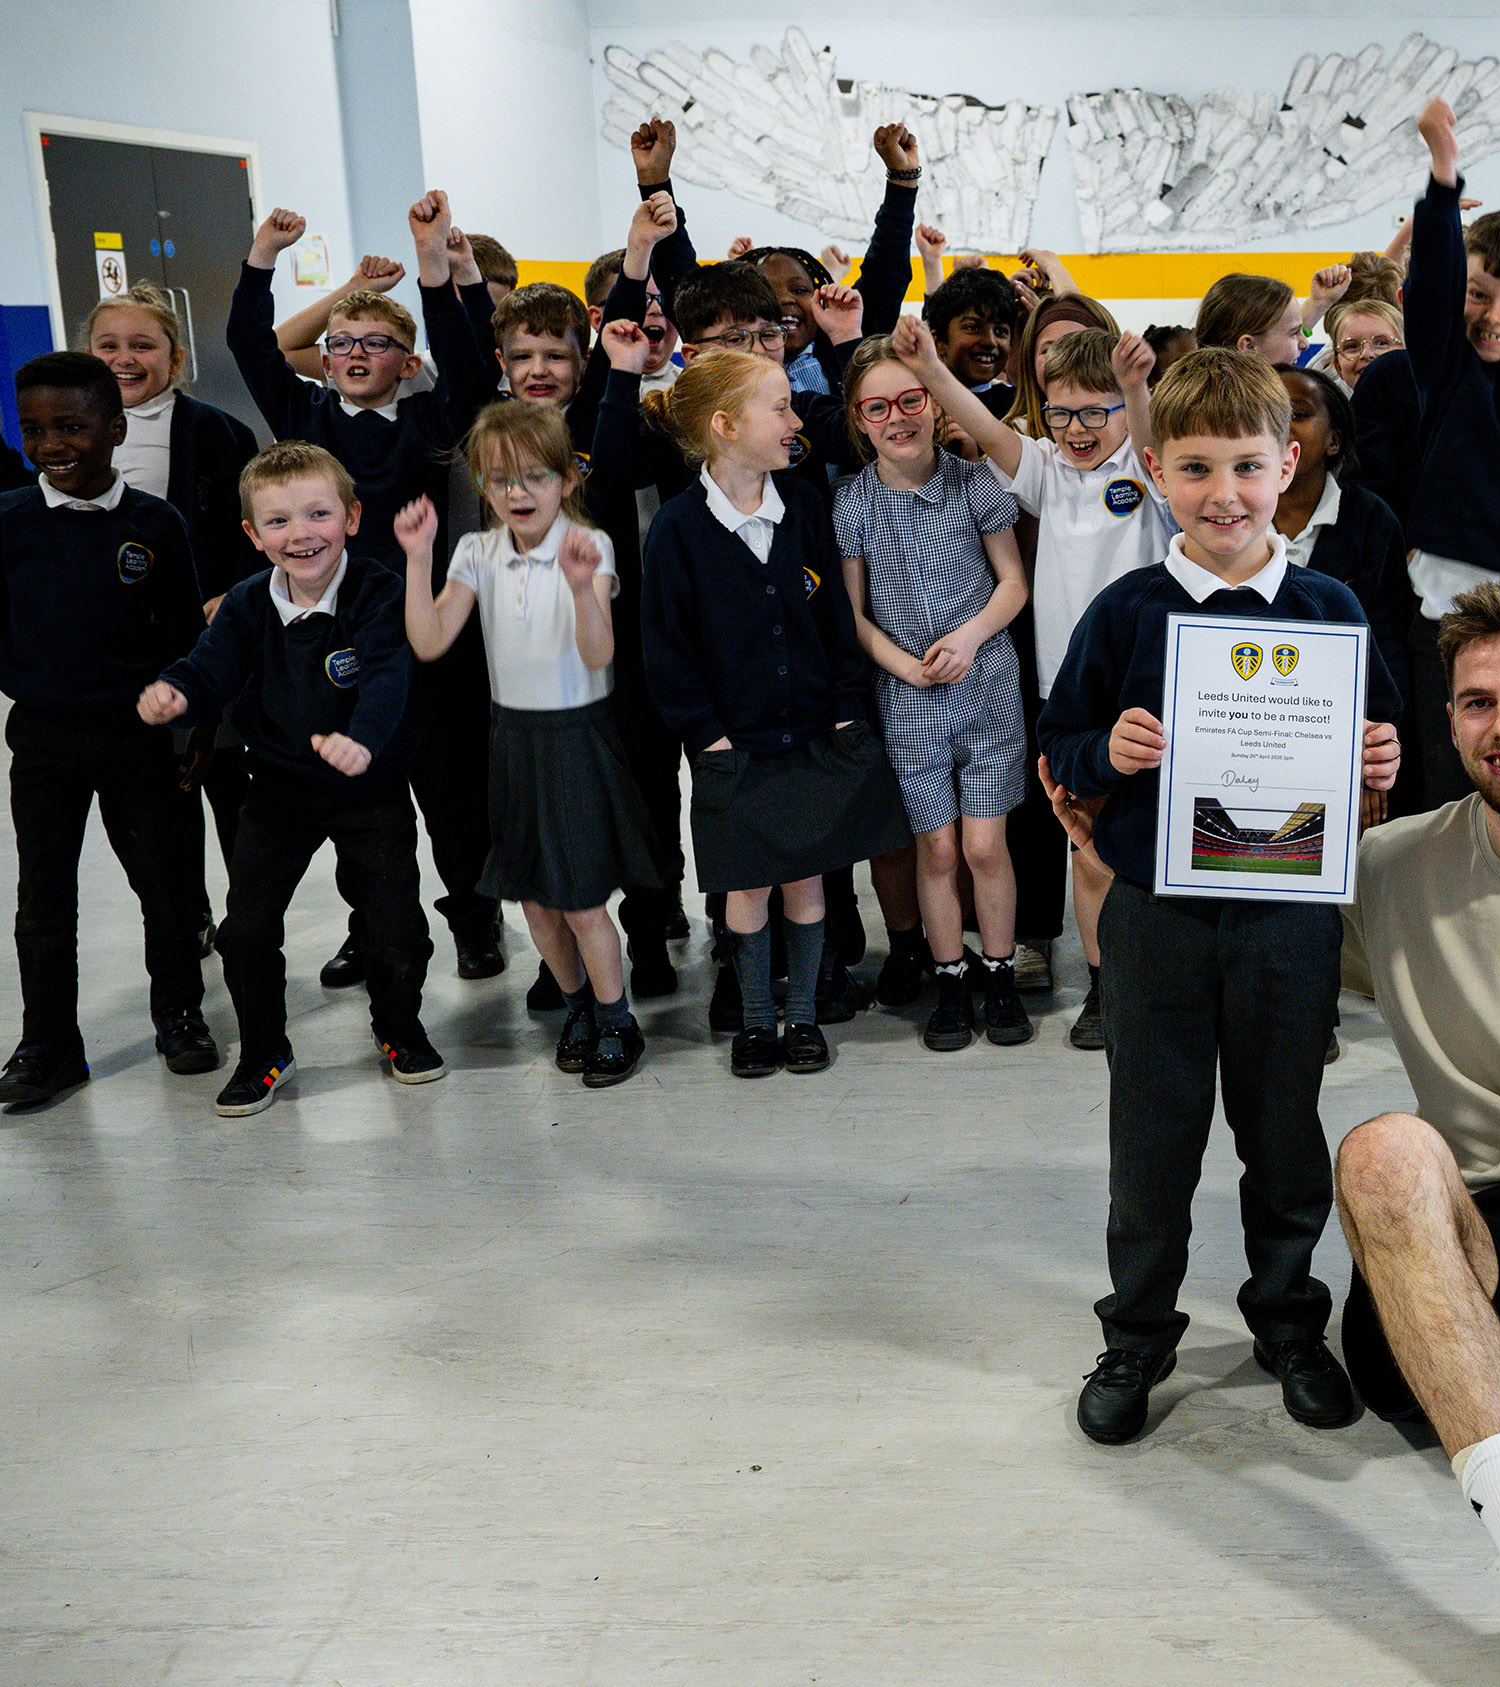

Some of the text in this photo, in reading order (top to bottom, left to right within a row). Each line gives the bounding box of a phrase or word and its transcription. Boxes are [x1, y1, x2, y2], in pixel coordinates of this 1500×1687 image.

[1109, 485, 1132, 494] Temple
[1111, 490, 1138, 500] Learning
[1197, 690, 1333, 708] Leeds United would like to
[1198, 707, 1331, 724] invite you to be a mascot!
[1195, 725, 1226, 734] Emirates
[1227, 727, 1237, 735] FA
[1237, 728, 1253, 737] Cup
[1253, 728, 1294, 738] Semi-Final:
[1294, 731, 1324, 740] Chelsea
[1240, 740, 1287, 749] Leeds United
[1231, 752, 1249, 760] Sunday
[1221, 769, 1260, 793] Daley
